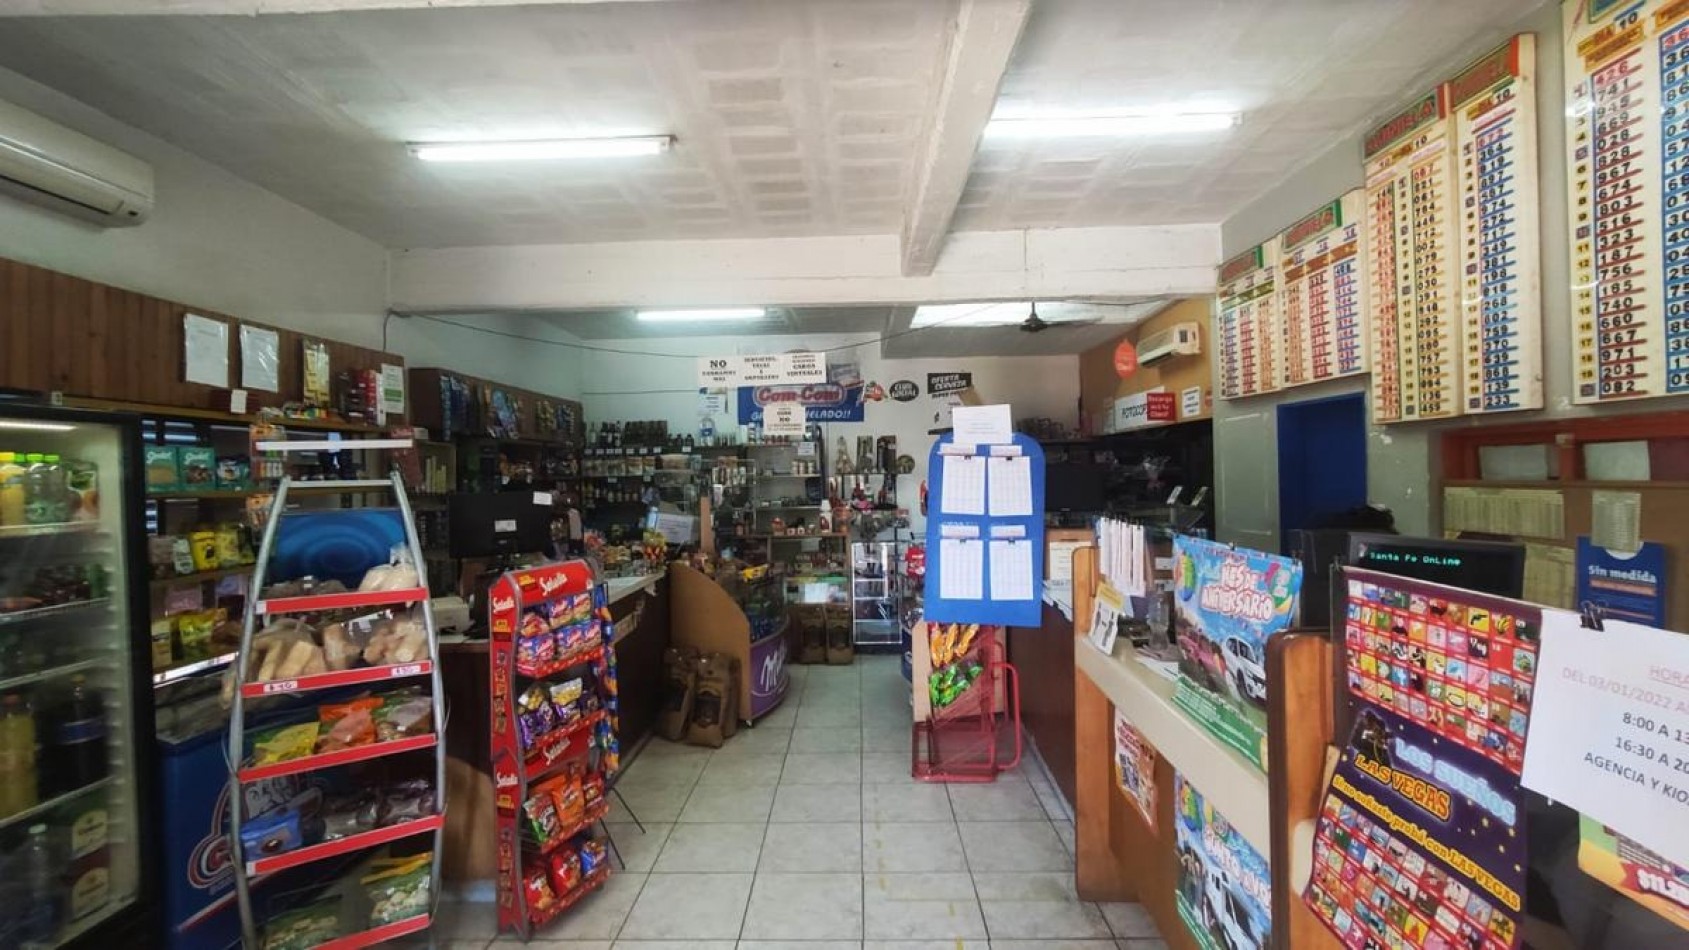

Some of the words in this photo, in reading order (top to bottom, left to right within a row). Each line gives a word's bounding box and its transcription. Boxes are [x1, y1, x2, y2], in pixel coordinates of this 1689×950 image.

[710, 359, 727, 368] NO
[1370, 552, 1399, 561] Santa
[1405, 554, 1418, 562] Fe
[1589, 565, 1606, 577] Sin
[1609, 569, 1657, 583] medida
[1622, 711, 1655, 732] 8:00
[1658, 724, 1669, 737] A
[1616, 736, 1655, 760] 16:30
[1658, 753, 1669, 766] A
[1355, 753, 1392, 784] LAS
[1391, 770, 1451, 821] VEGAS
[1584, 752, 1646, 786] AGENCIA
[1651, 776, 1660, 790] Y
[1662, 783, 1689, 806] KIO
